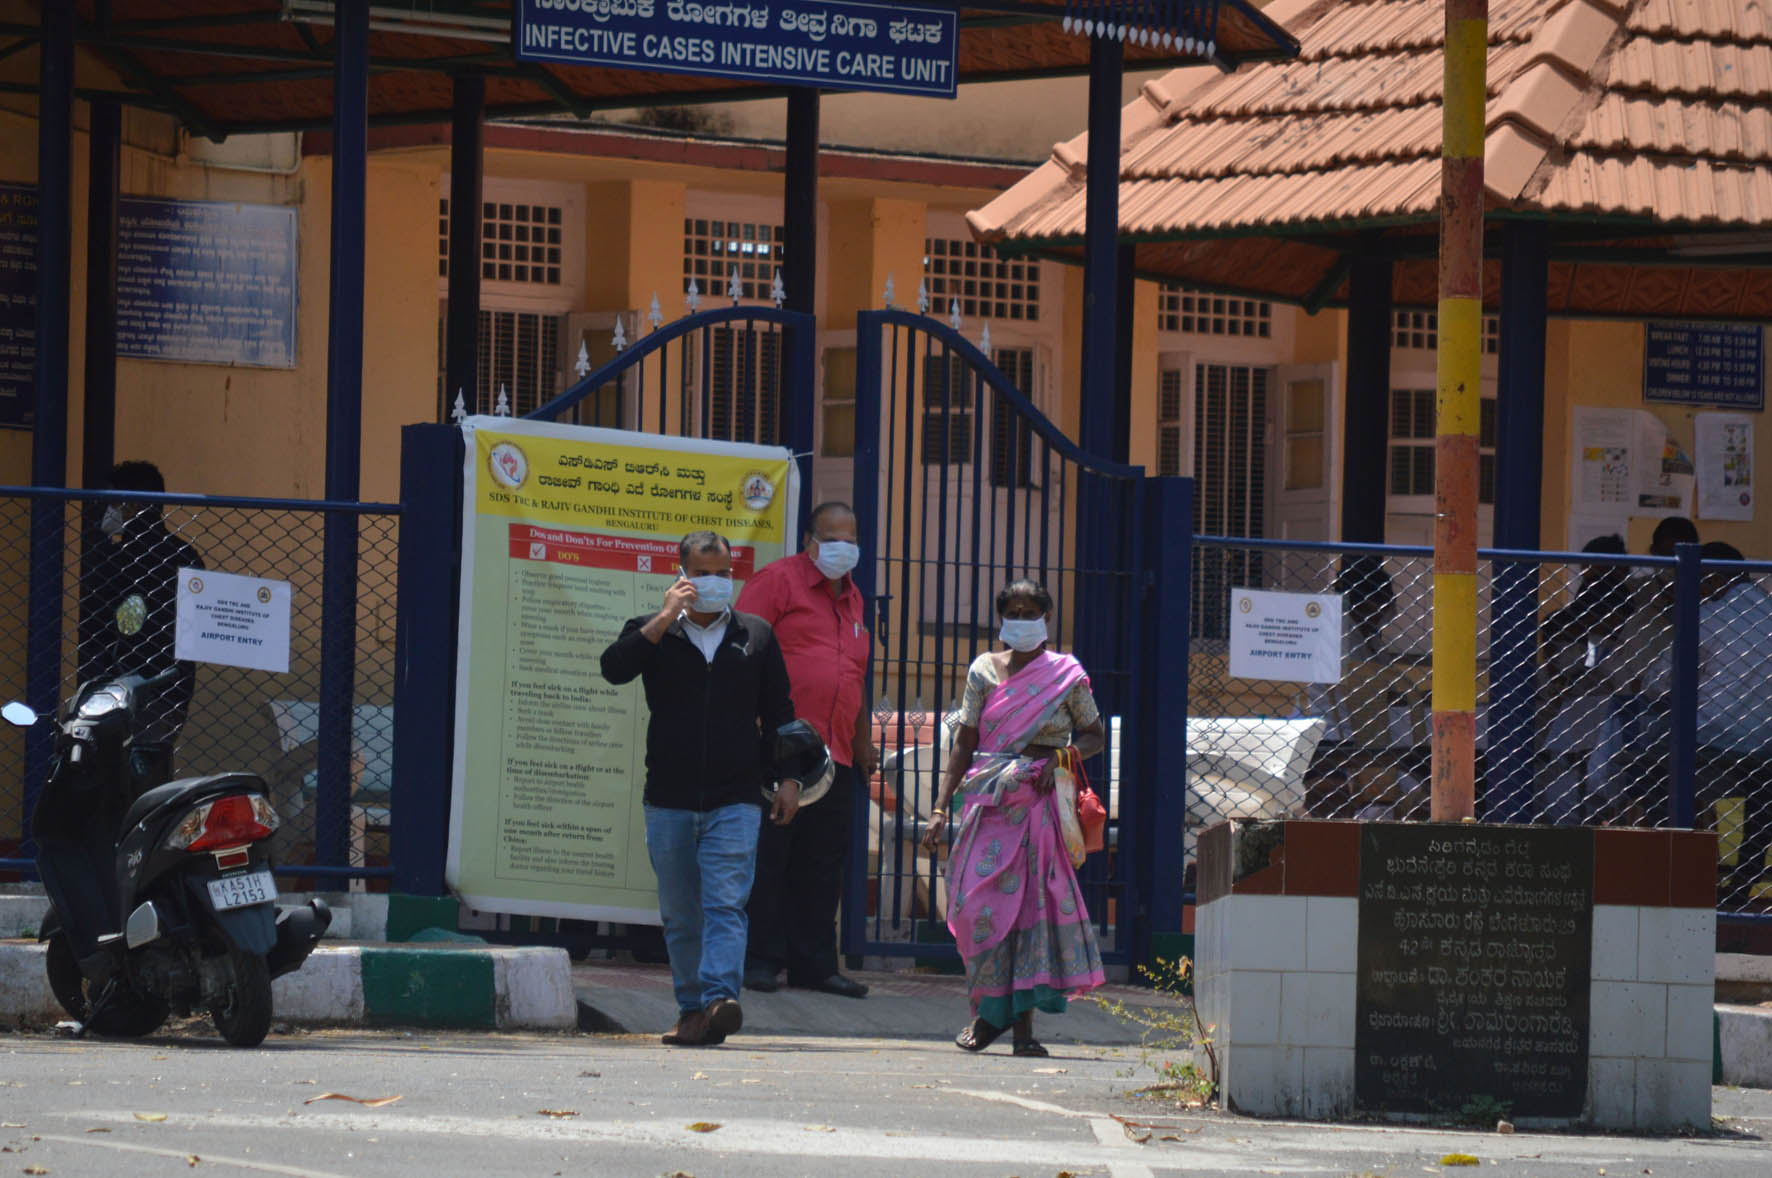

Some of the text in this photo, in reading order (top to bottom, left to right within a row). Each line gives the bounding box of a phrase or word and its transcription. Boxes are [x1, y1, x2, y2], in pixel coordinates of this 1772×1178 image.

[667, 1, 768, 29] ರೋಗಗಳ
[889, 17, 943, 44] ಘಟಕ
[525, 23, 950, 83] INFECTIVE CASES INTENSIVE CARE UNIT
[489, 492, 511, 504] SDS
[541, 500, 571, 512] RAJIV
[573, 503, 615, 516] GANDHI
[618, 507, 672, 522] INSTITUTE
[674, 514, 688, 523] OF
[690, 514, 722, 527] CHEST
[597, 537, 614, 549] For
[615, 540, 665, 554] Prevention
[667, 544, 679, 554] Of
[201, 631, 263, 646] AIRPORT ENTRY
[1249, 649, 1312, 660] AIRPORT ENTRY
[220, 875, 262, 893] KA51H
[224, 888, 265, 906] L2153
